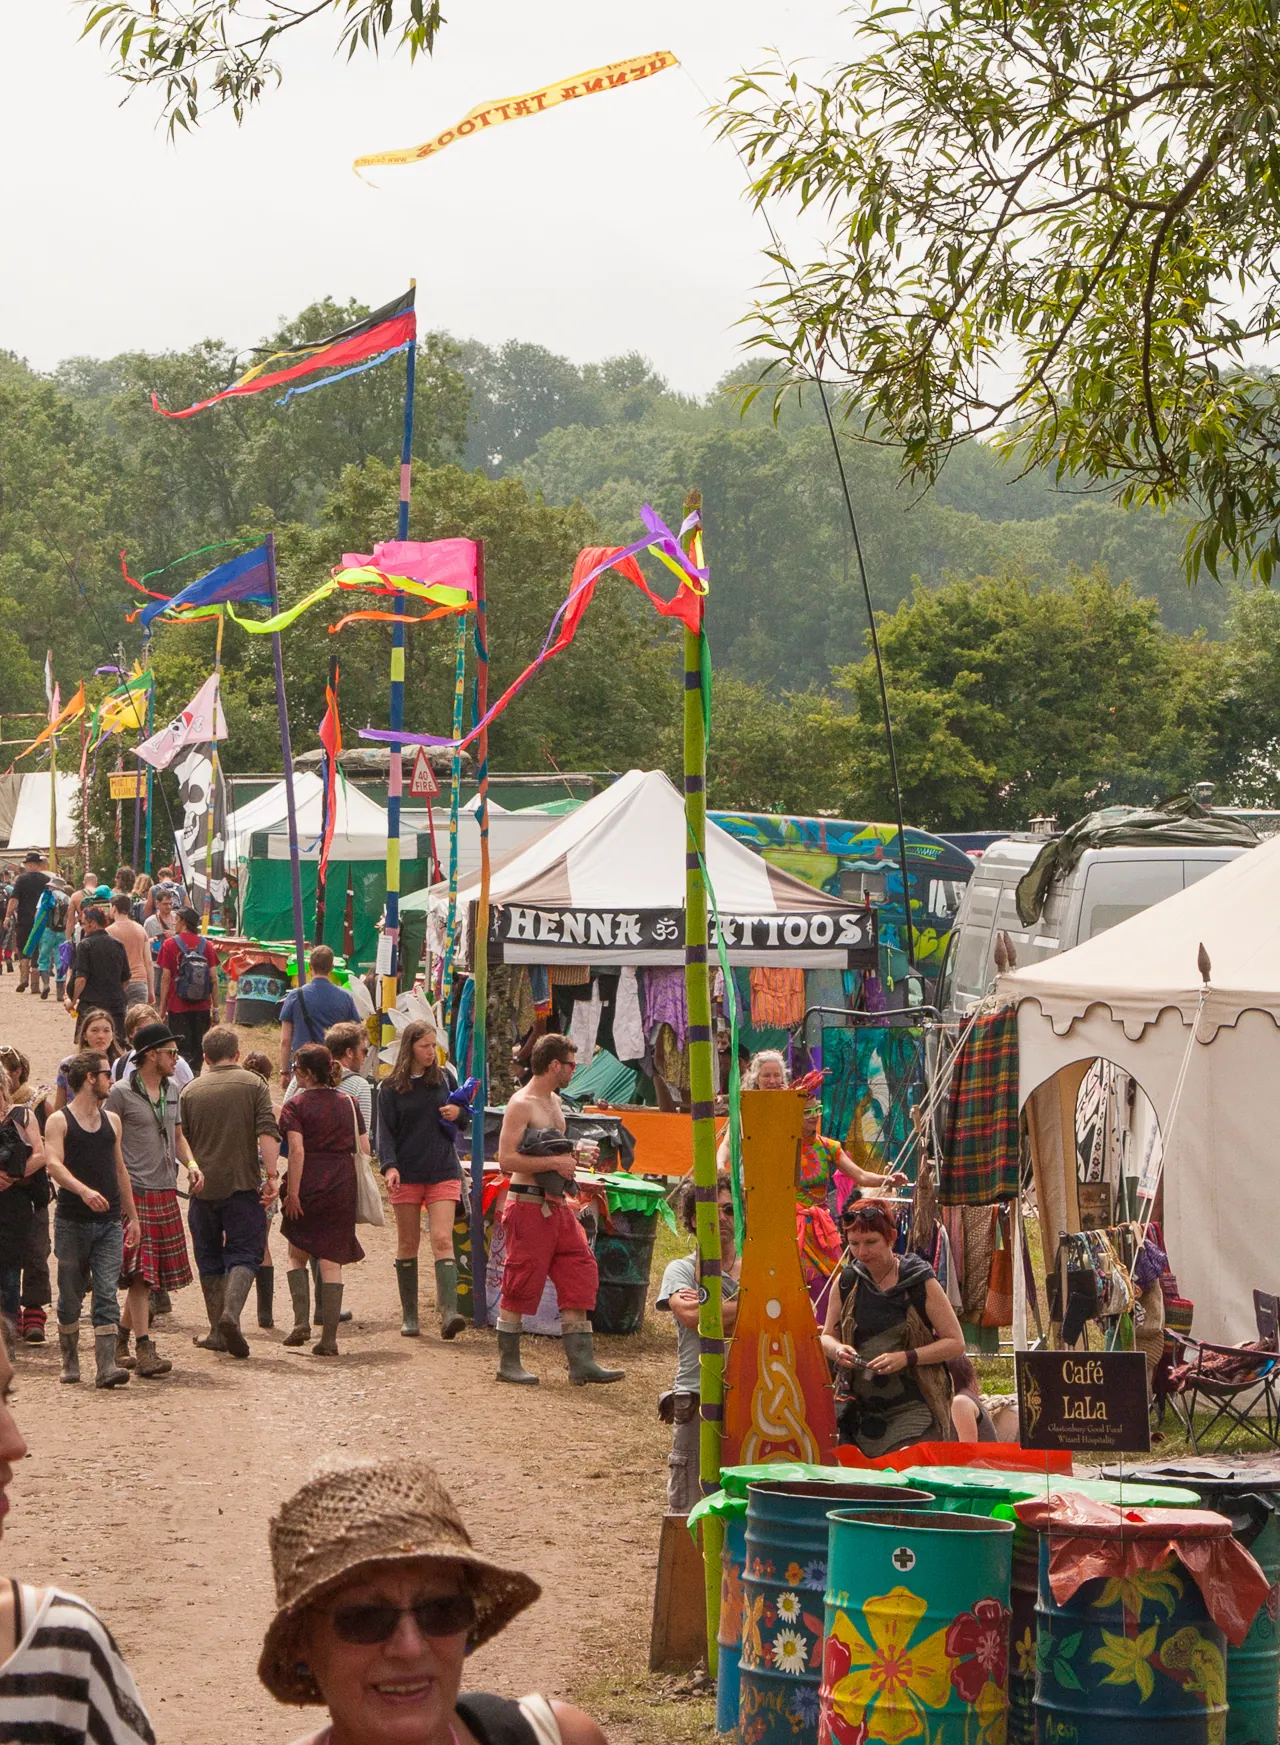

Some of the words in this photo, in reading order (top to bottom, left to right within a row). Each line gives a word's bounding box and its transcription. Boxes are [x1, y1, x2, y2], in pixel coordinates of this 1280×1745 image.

[418, 771, 429, 781] 40
[415, 781, 433, 791] FIRE
[507, 907, 643, 946] HENNA
[708, 914, 863, 947] ATTOOS
[1062, 1360, 1104, 1385] Café
[1062, 1396, 1108, 1420] LaLa
[1087, 1424, 1105, 1434] Good
[1106, 1424, 1123, 1434] Food
